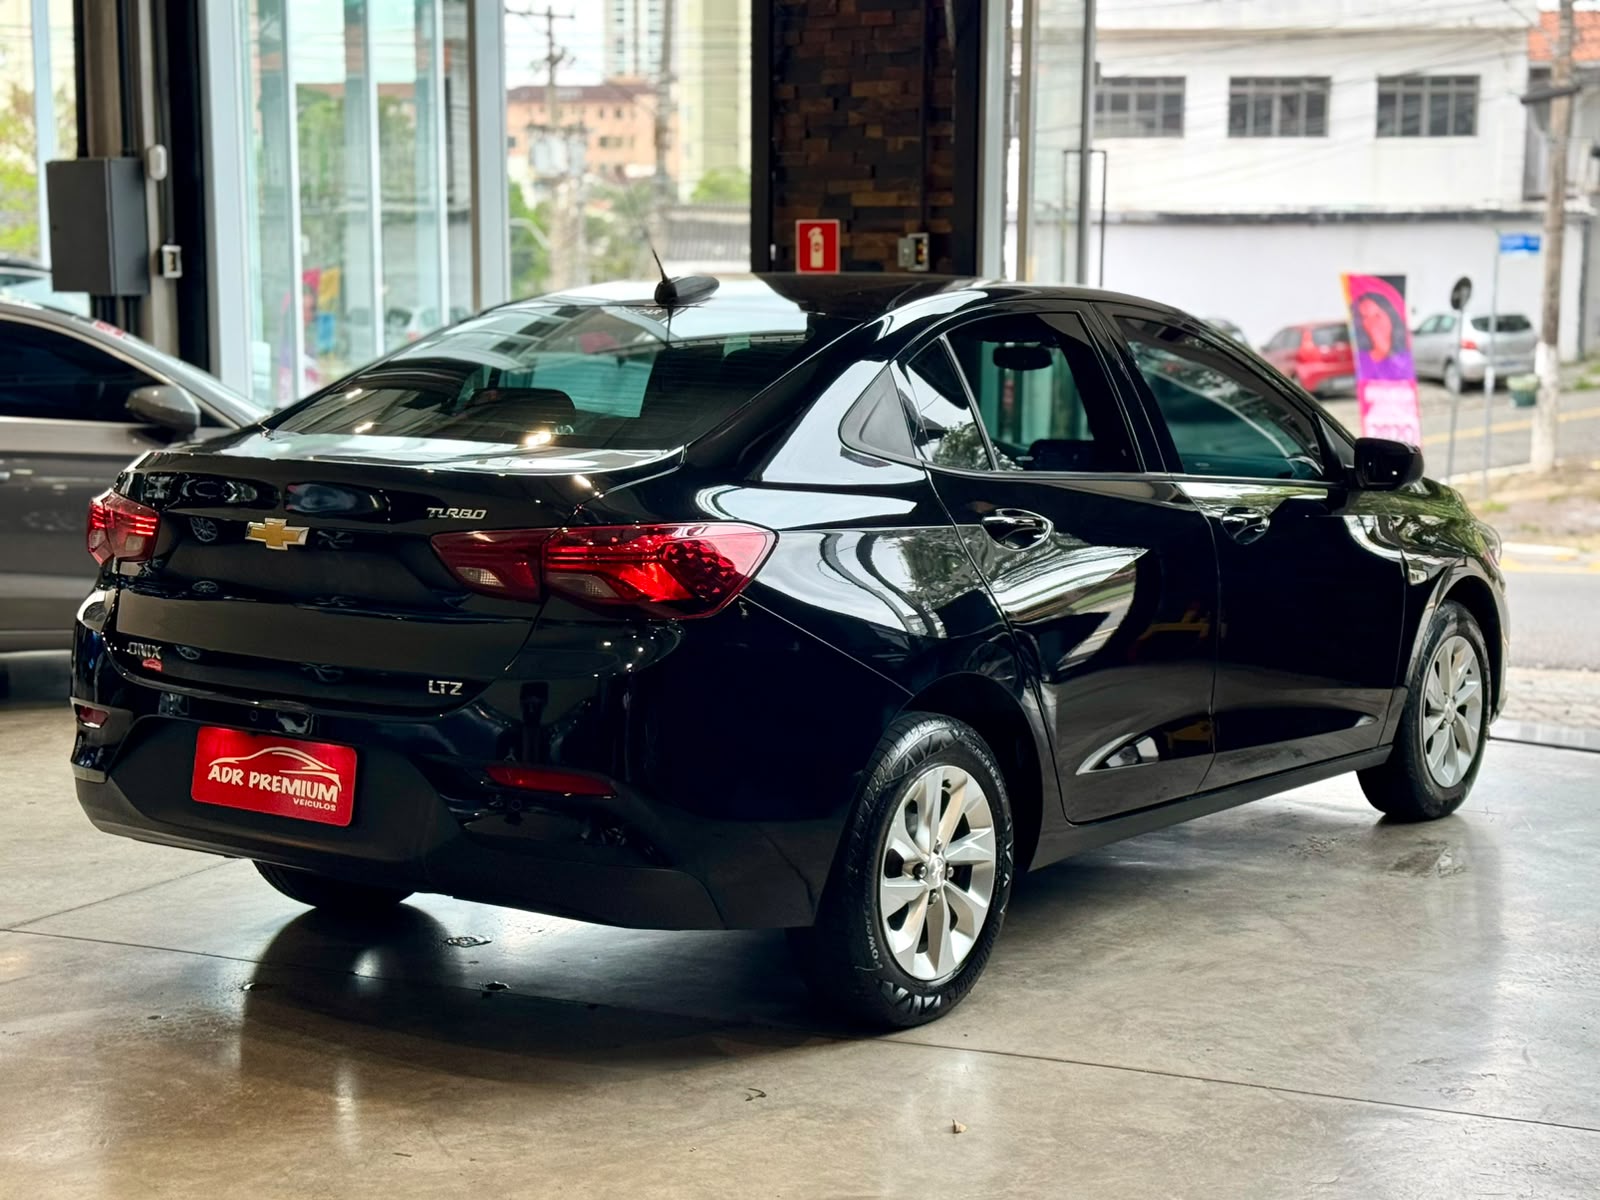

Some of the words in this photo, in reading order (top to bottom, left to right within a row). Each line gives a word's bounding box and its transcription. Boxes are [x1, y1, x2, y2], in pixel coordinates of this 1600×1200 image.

[426, 507, 487, 520] TURBO
[128, 641, 162, 660] ONIX
[428, 679, 463, 696] LTZ
[207, 764, 244, 786] ADR
[248, 771, 338, 803] PREMIUM
[293, 797, 337, 812] VEICULOS
